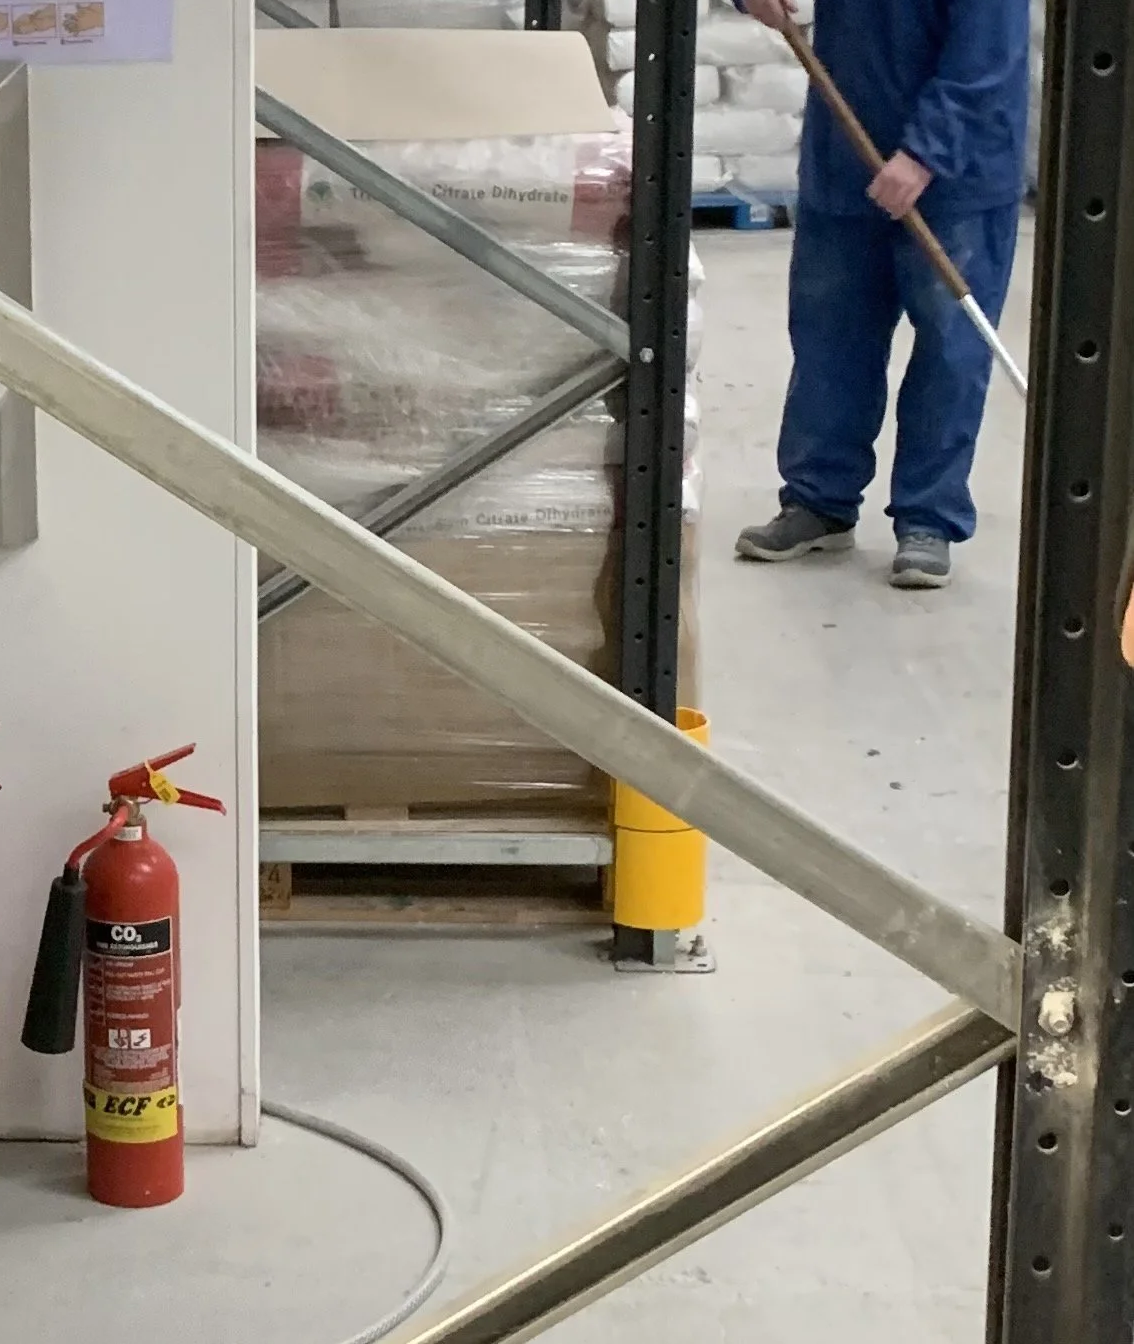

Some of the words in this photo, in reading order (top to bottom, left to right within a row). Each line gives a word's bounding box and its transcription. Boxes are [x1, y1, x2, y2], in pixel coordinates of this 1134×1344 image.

[432, 184, 485, 201] Citrate
[492, 185, 569, 204] Dihydrate
[104, 1095, 152, 1116] ECF
